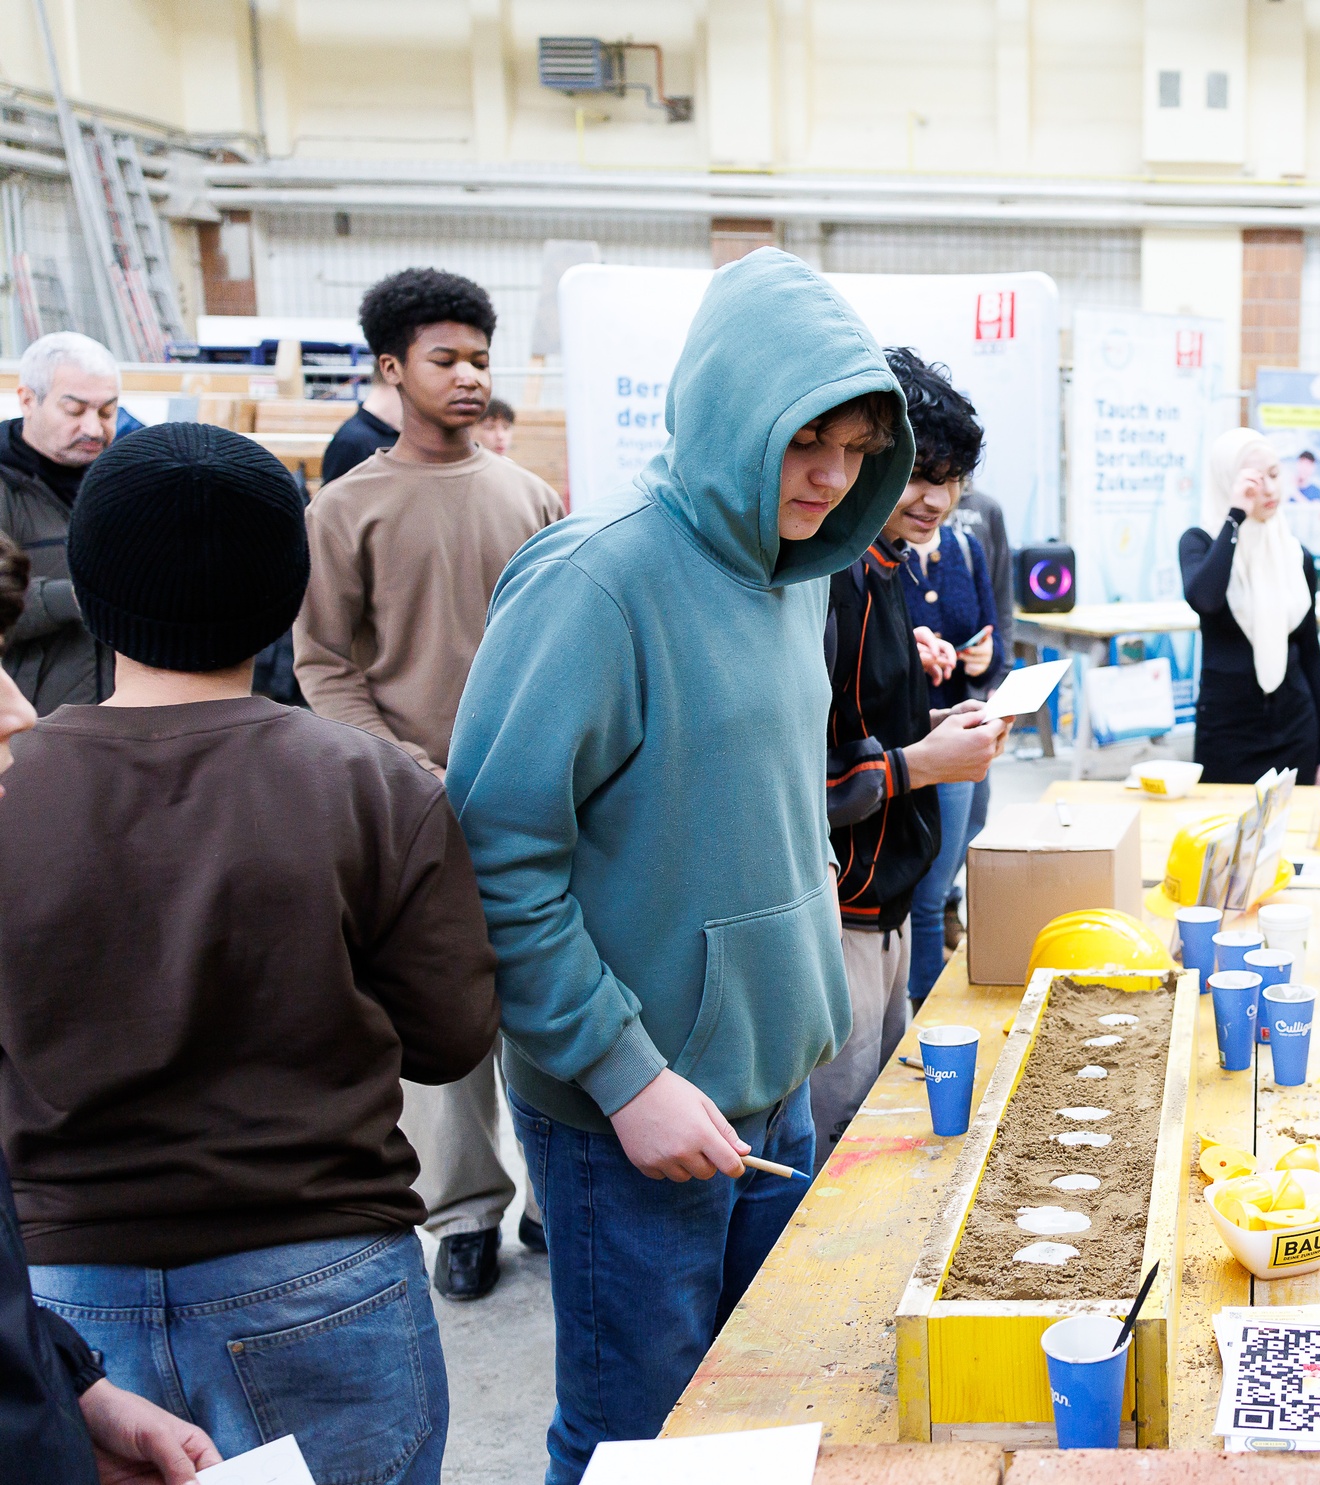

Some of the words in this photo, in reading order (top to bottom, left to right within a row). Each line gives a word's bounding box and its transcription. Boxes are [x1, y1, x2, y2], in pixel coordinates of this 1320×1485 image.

[617, 376, 669, 397] Ber
[1096, 399, 1149, 418] Tauch
[1156, 406, 1180, 419] ein
[1095, 427, 1112, 442] in
[1119, 428, 1166, 443] deine
[1096, 450, 1186, 467] berufliche
